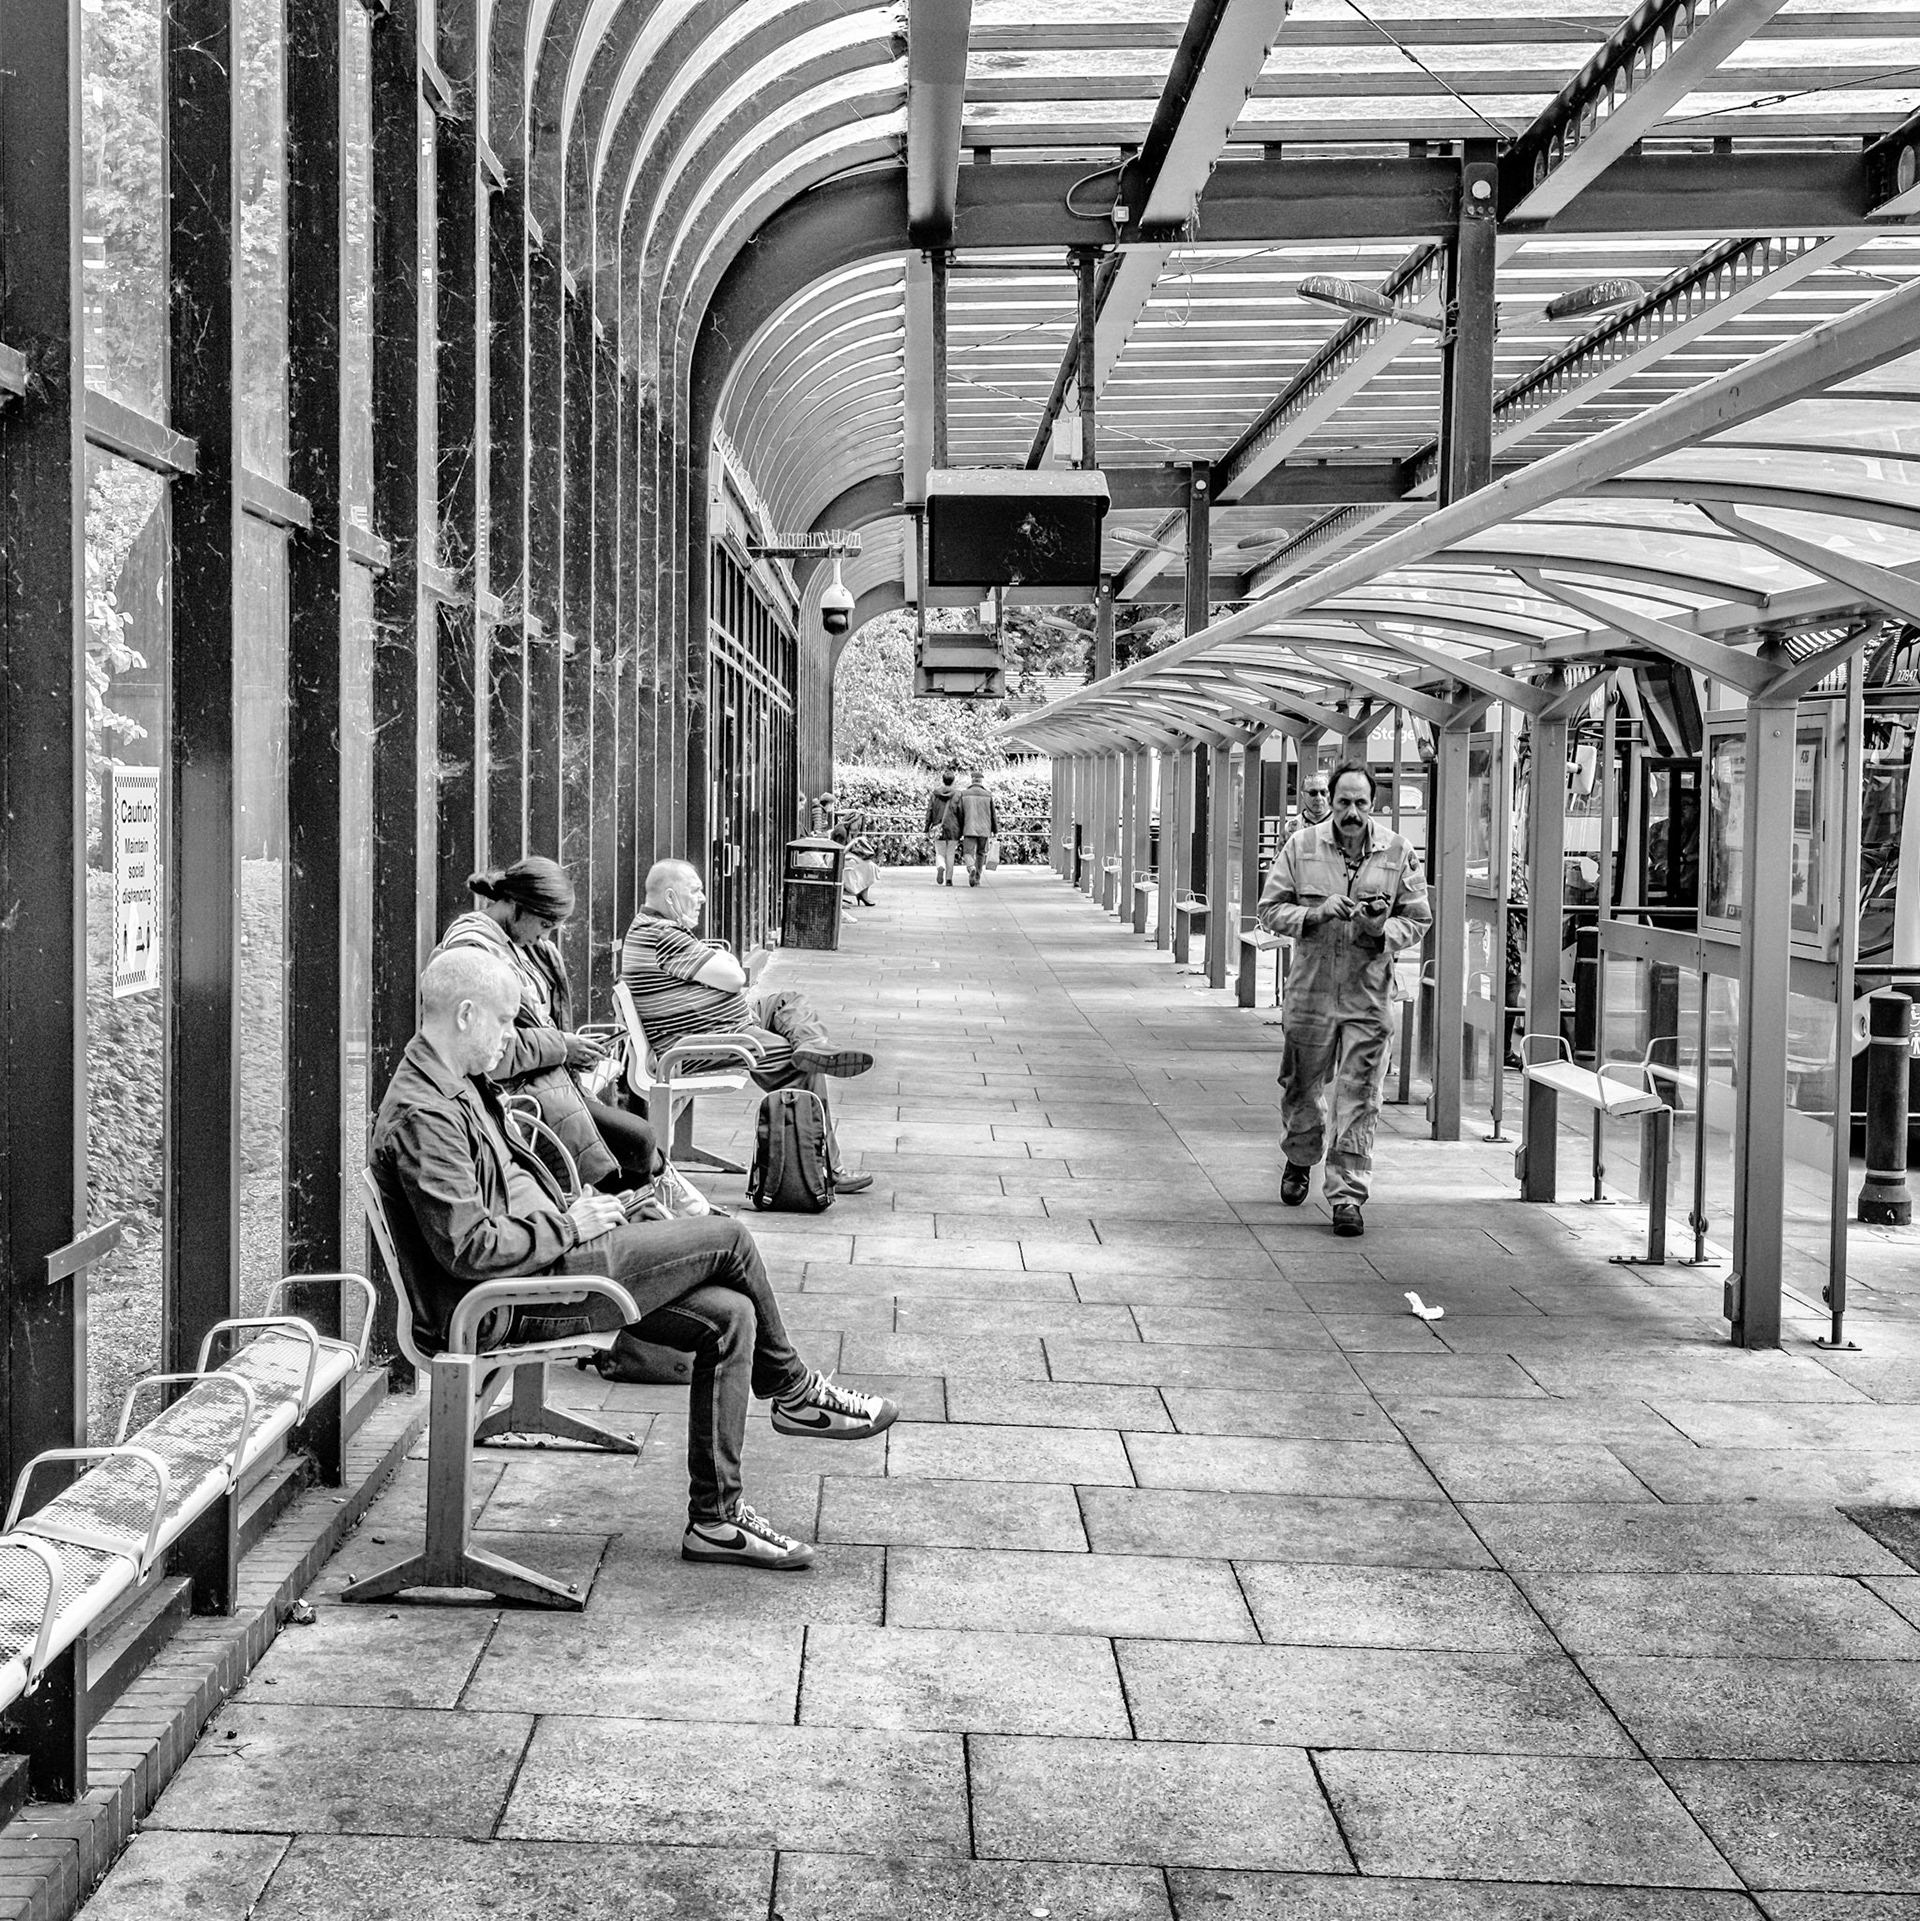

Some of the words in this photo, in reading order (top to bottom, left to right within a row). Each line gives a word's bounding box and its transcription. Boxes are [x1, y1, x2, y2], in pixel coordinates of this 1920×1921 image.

[1897, 669, 1918, 682] 27847
[121, 799, 152, 823] Caution
[124, 837, 149, 854] Maintain
[128, 861, 145, 879] social
[122, 886, 151, 905] distancing
